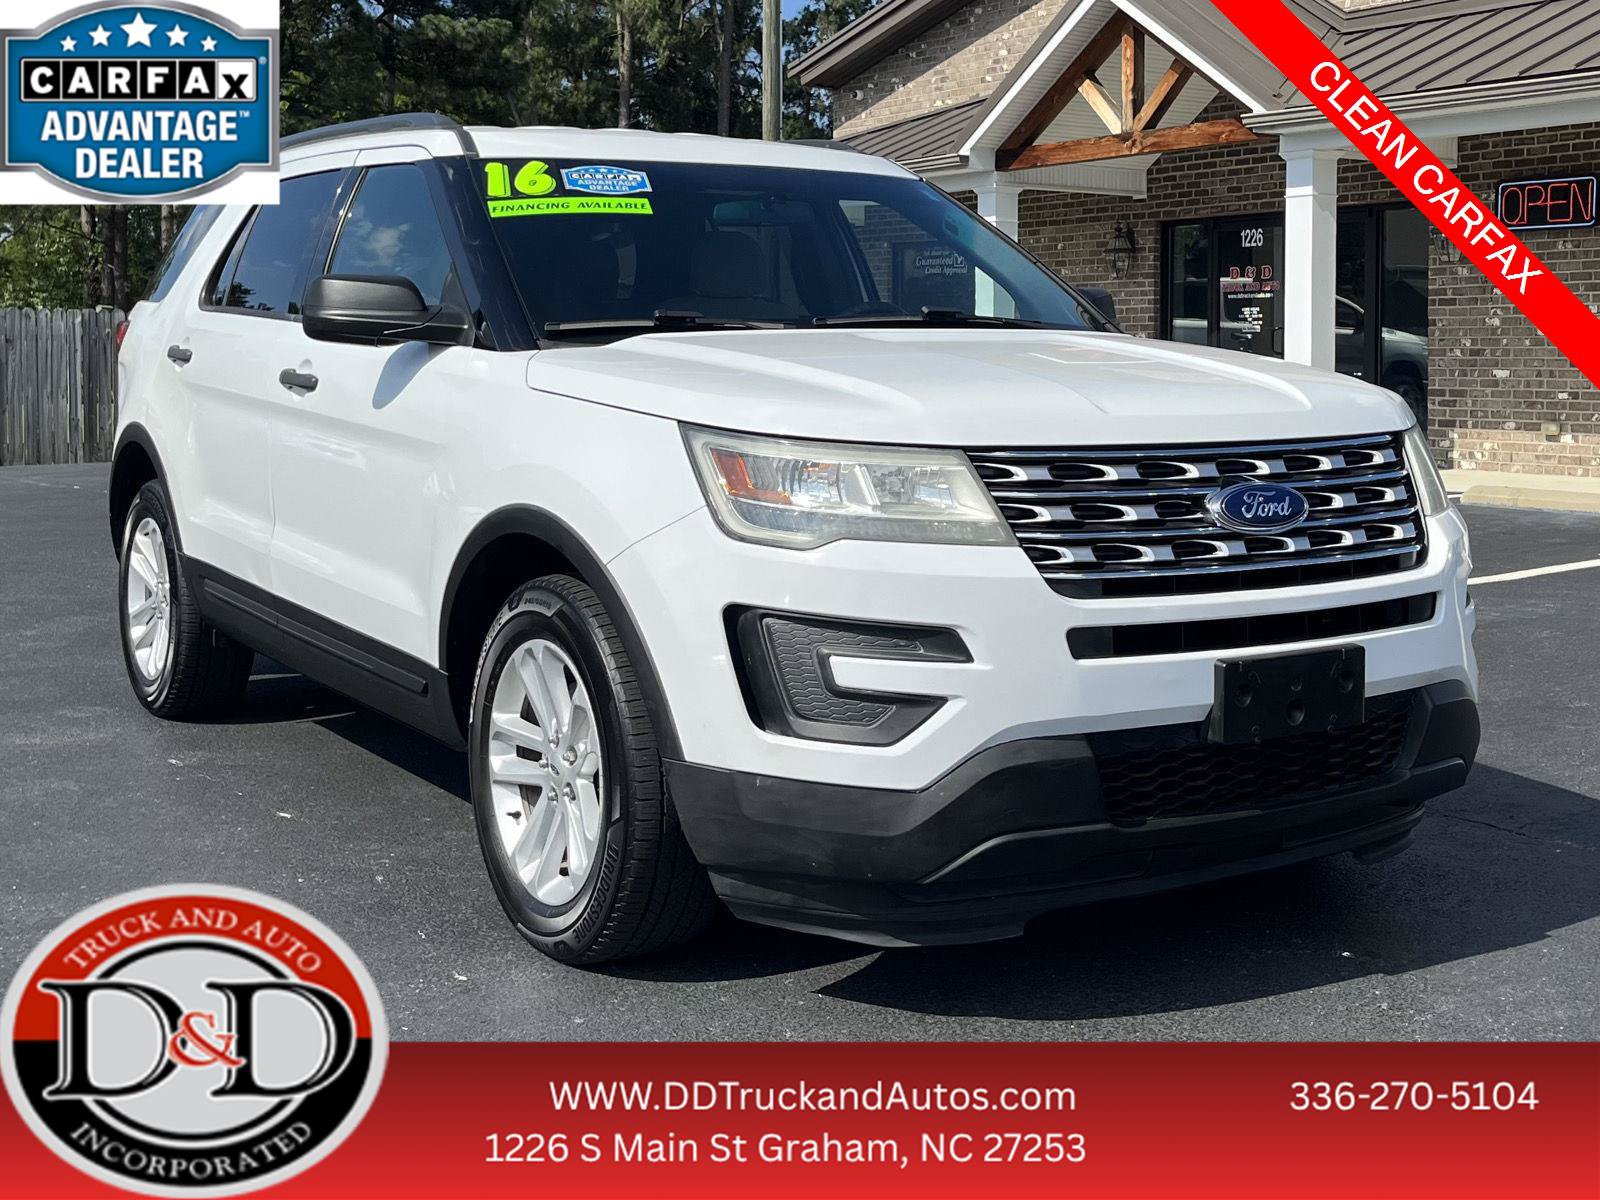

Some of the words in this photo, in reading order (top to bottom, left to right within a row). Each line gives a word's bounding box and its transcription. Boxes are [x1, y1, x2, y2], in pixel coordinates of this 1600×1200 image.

[484, 160, 557, 197] 16
[577, 179, 638, 187] ADVANTAGE
[589, 184, 630, 192] DEALER
[492, 202, 570, 213] FINANCING
[577, 201, 648, 210] AVAILABLE
[1502, 181, 1593, 225] OPEN
[1240, 228, 1264, 248] 1226
[915, 255, 954, 266] Guaranteed
[1230, 267, 1240, 279] D
[1261, 265, 1272, 279] D
[1241, 491, 1292, 518] Ford
